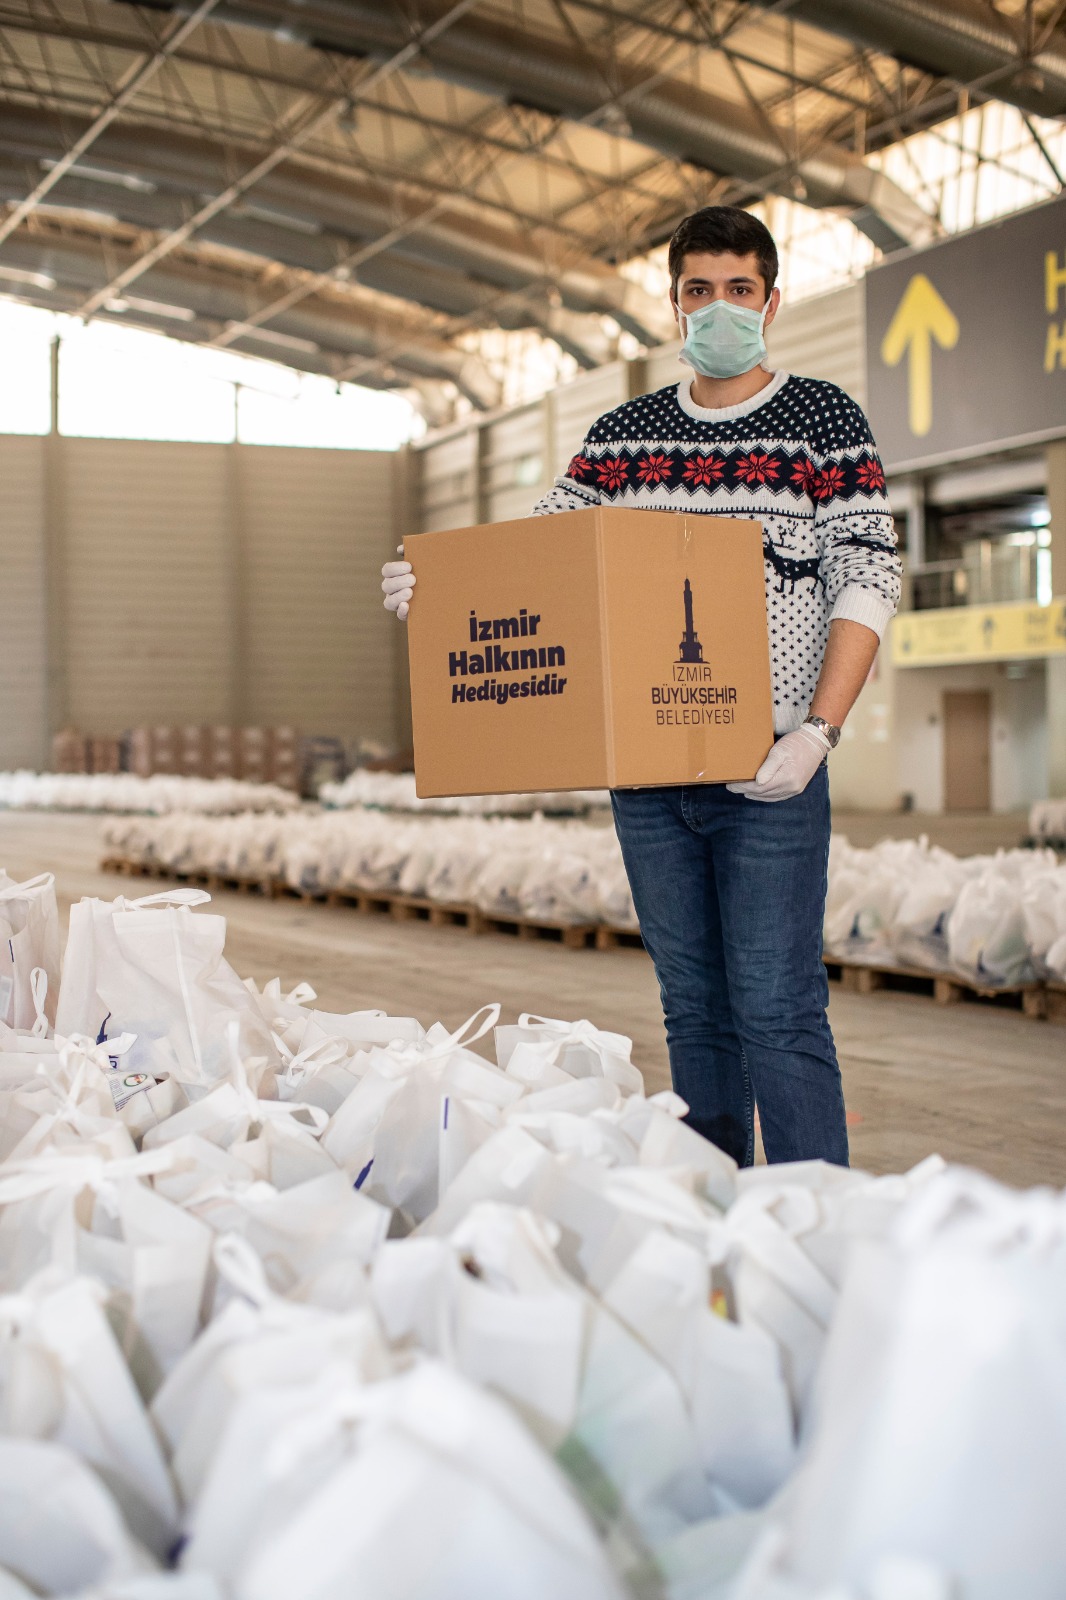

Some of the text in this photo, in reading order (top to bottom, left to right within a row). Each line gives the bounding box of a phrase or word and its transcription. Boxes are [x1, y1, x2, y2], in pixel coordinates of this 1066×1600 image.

[469, 608, 541, 642] İzmir
[448, 645, 566, 677] Halkının
[672, 664, 712, 682] İZMİR
[451, 673, 567, 705] Hediyesidir
[651, 683, 737, 706] BÜYÜKŞEHİR
[656, 707, 735, 725] BELEDİYESİ
